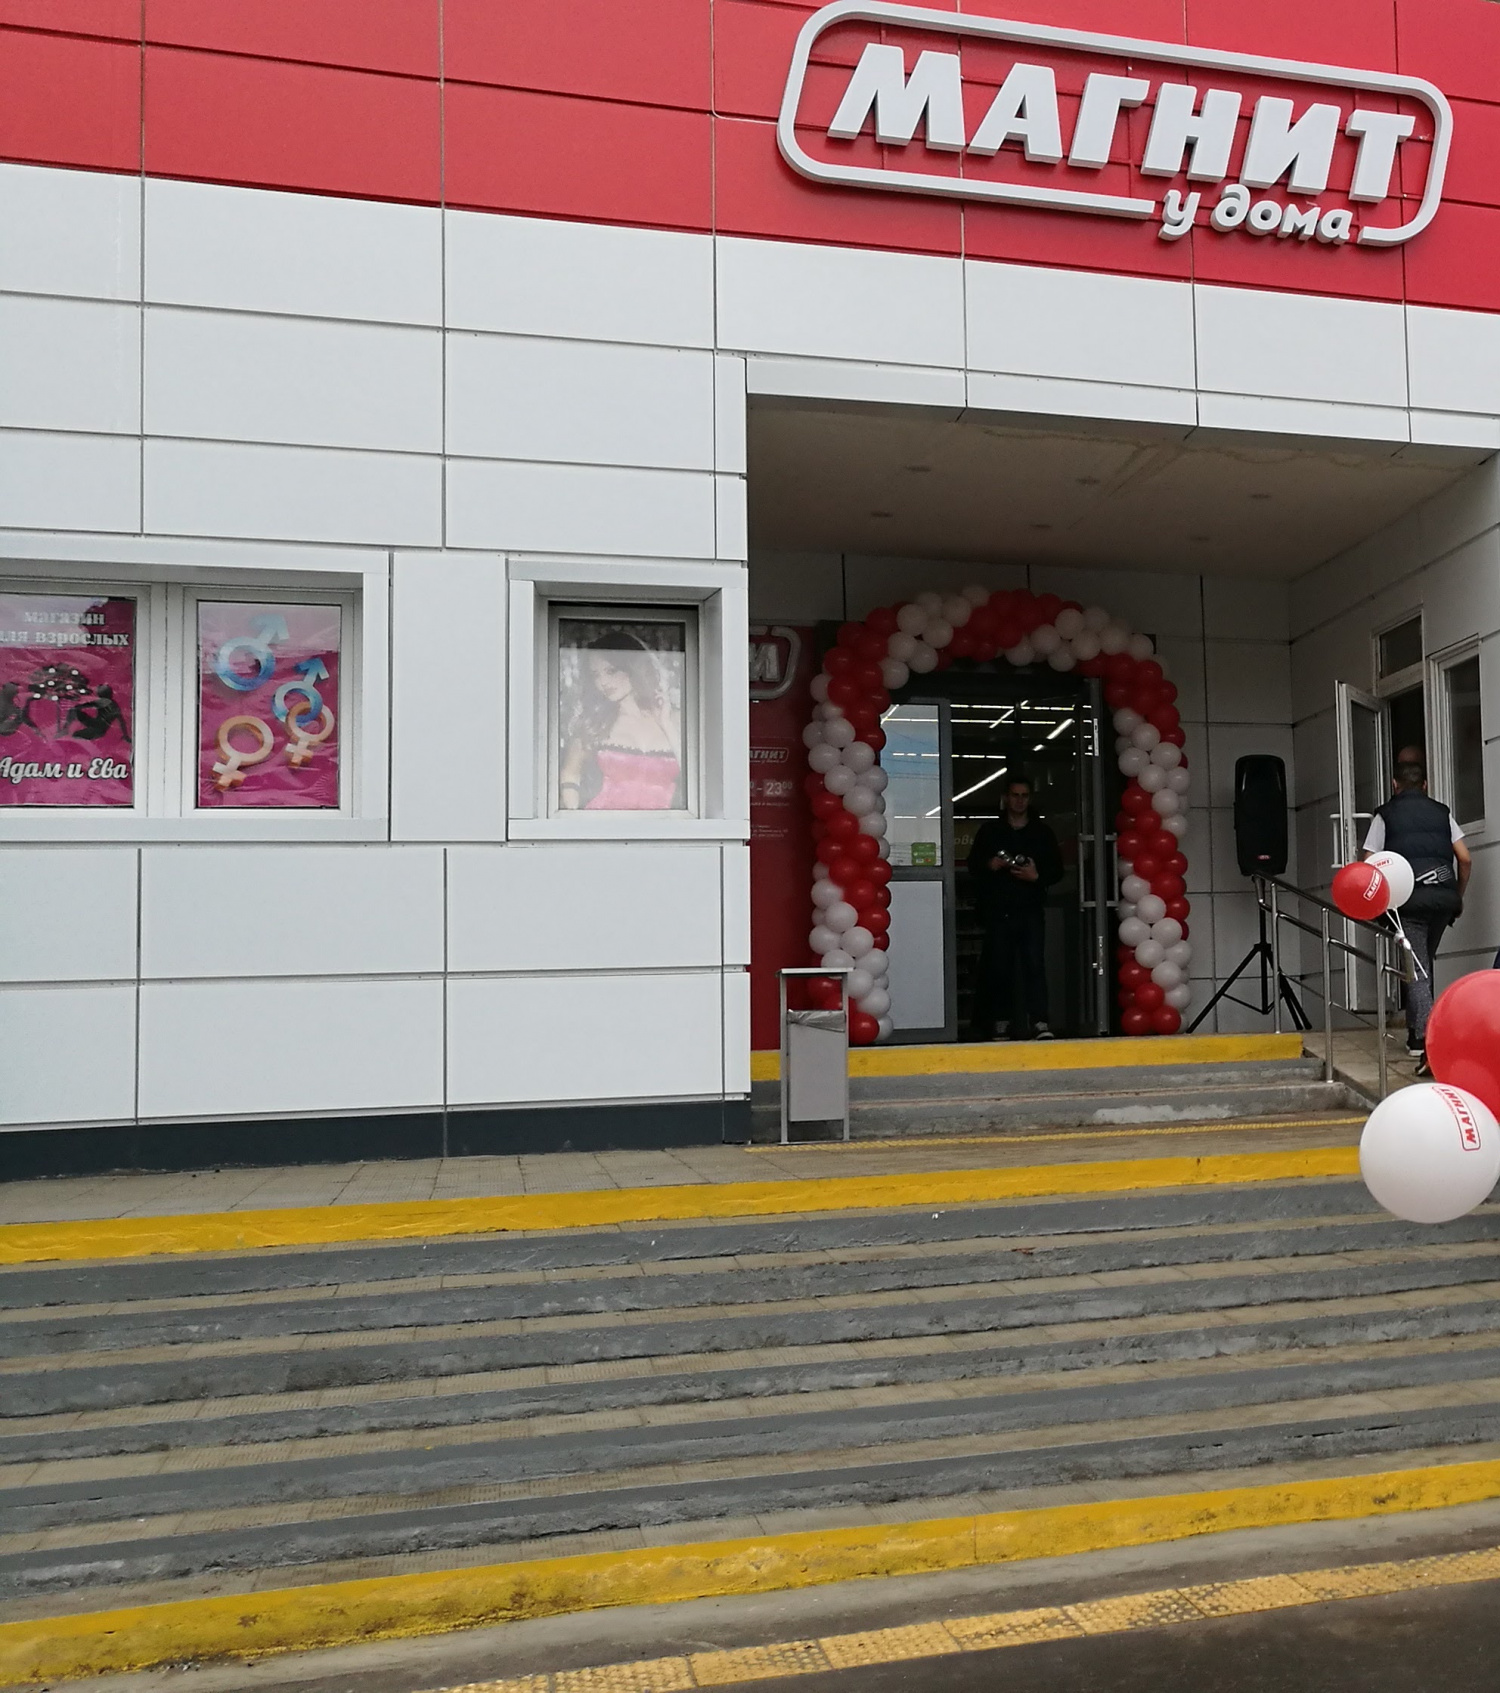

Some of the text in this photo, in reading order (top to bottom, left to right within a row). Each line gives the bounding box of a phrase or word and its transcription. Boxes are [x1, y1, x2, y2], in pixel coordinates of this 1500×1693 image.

[827, 43, 1416, 203] МАГНИТ
[1158, 183, 1353, 245] у дома
[24, 611, 105, 625] магазин
[35, 631, 129, 647] взрослых
[0, 757, 128, 784] Адам и Ева
[1440, 1087, 1477, 1144] МАГНИТ
